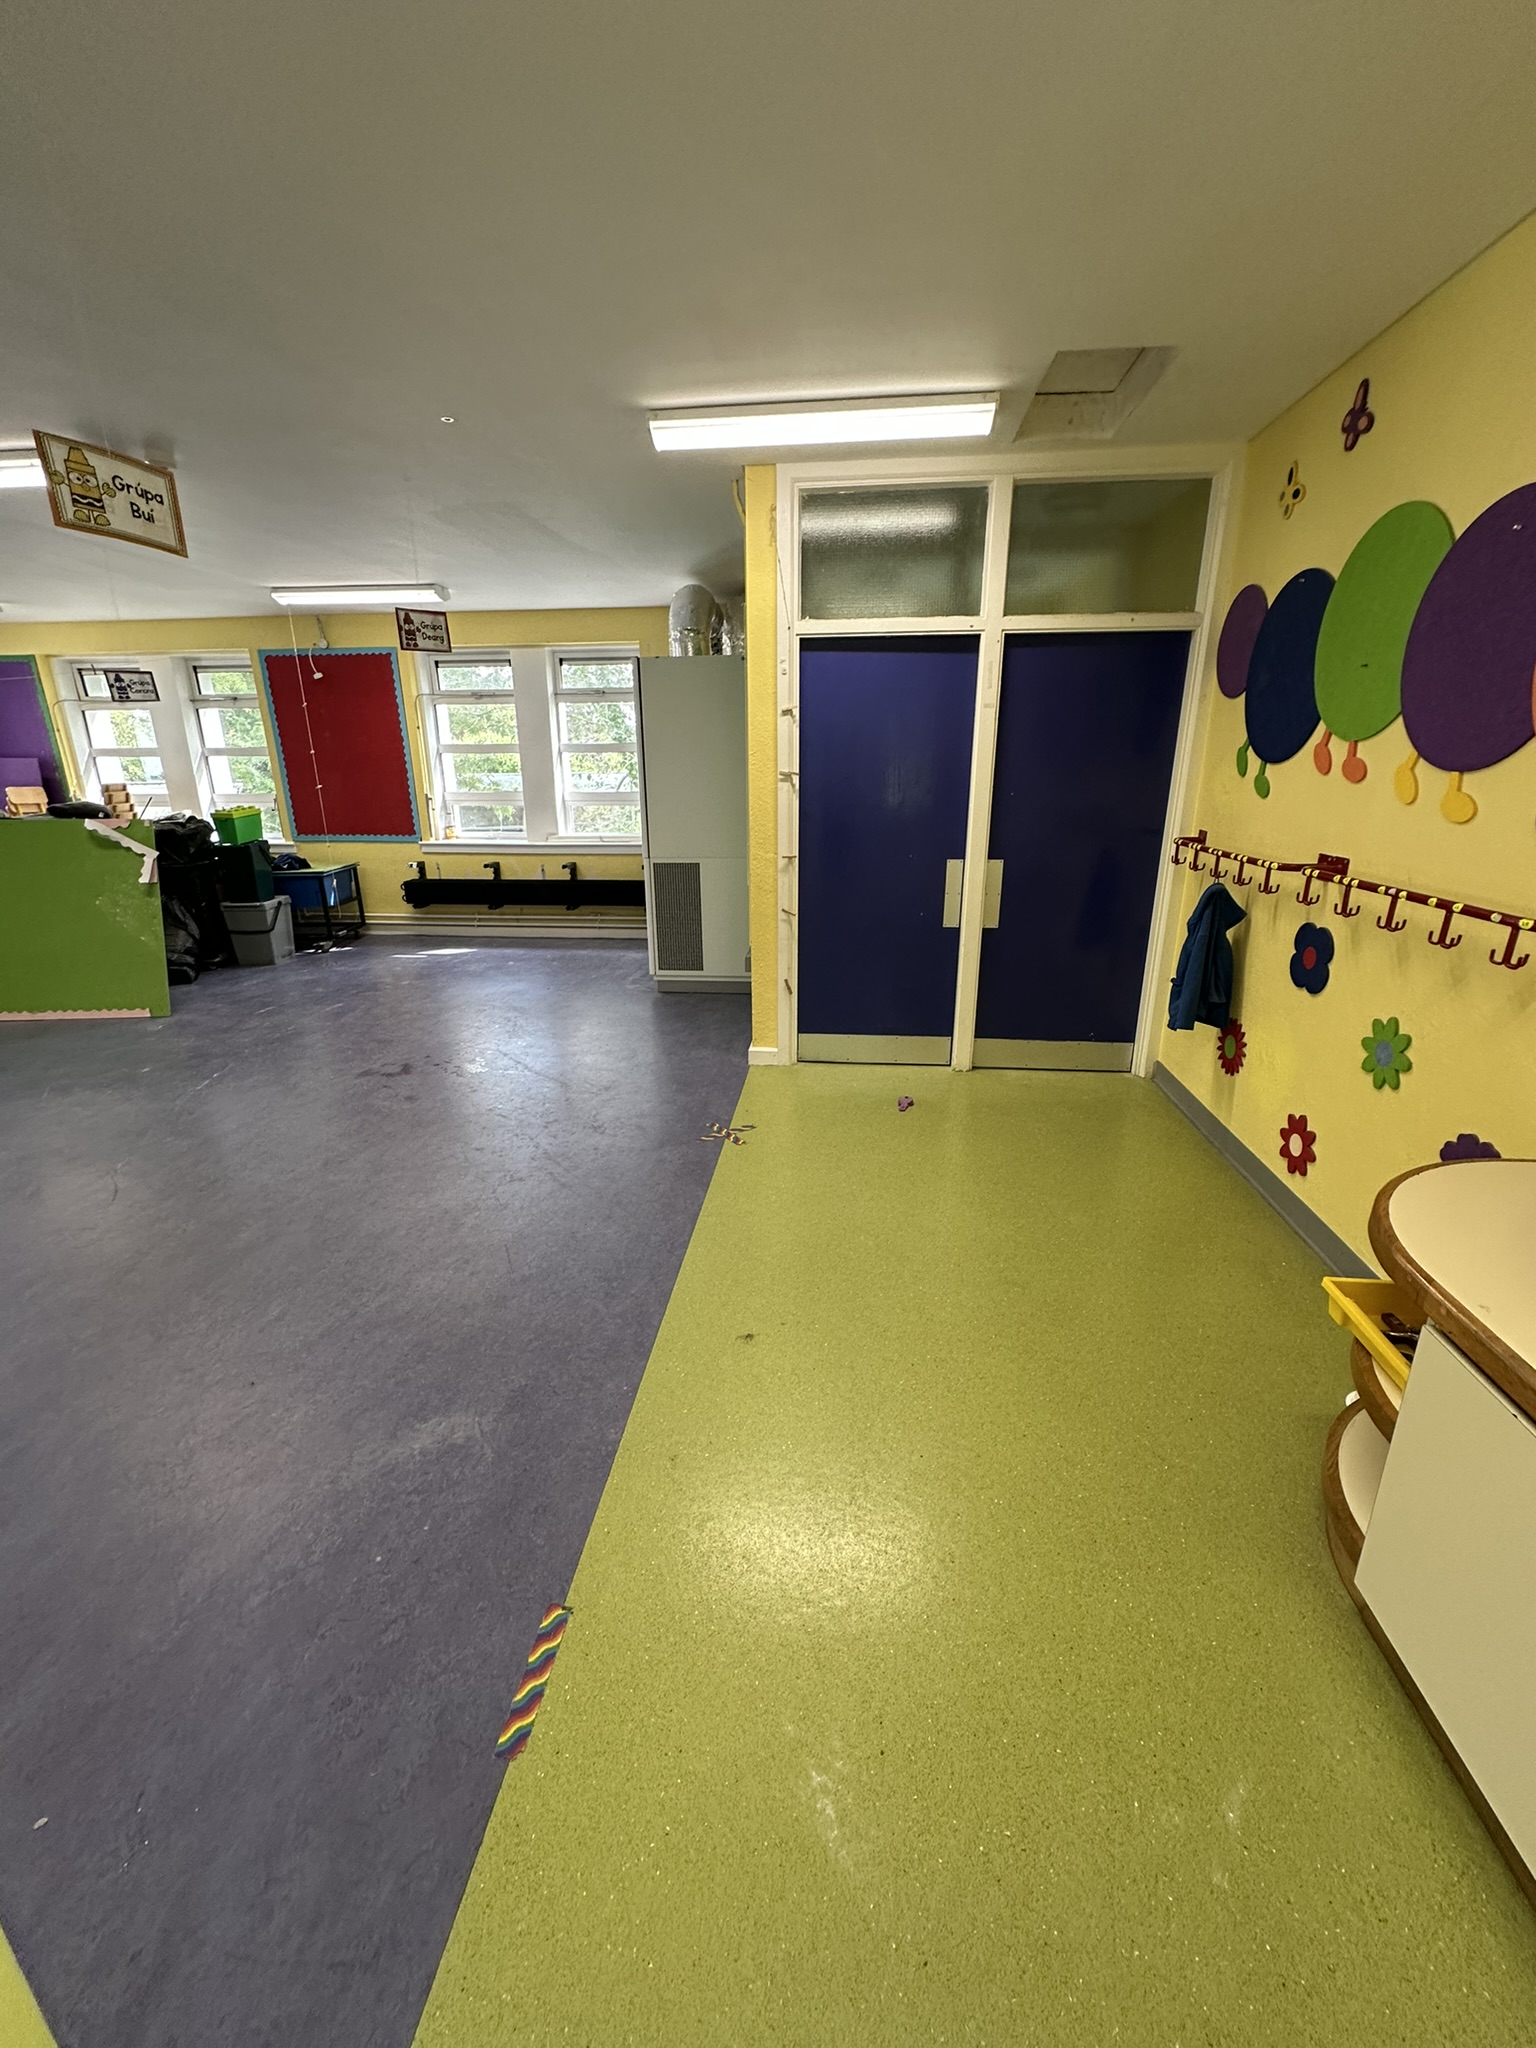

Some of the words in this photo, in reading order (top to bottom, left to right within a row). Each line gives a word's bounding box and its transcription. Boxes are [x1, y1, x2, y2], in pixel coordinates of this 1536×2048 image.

[112, 475, 164, 505] Grúpa
[130, 501, 155, 523] Buí
[422, 632, 445, 644] Dearg
